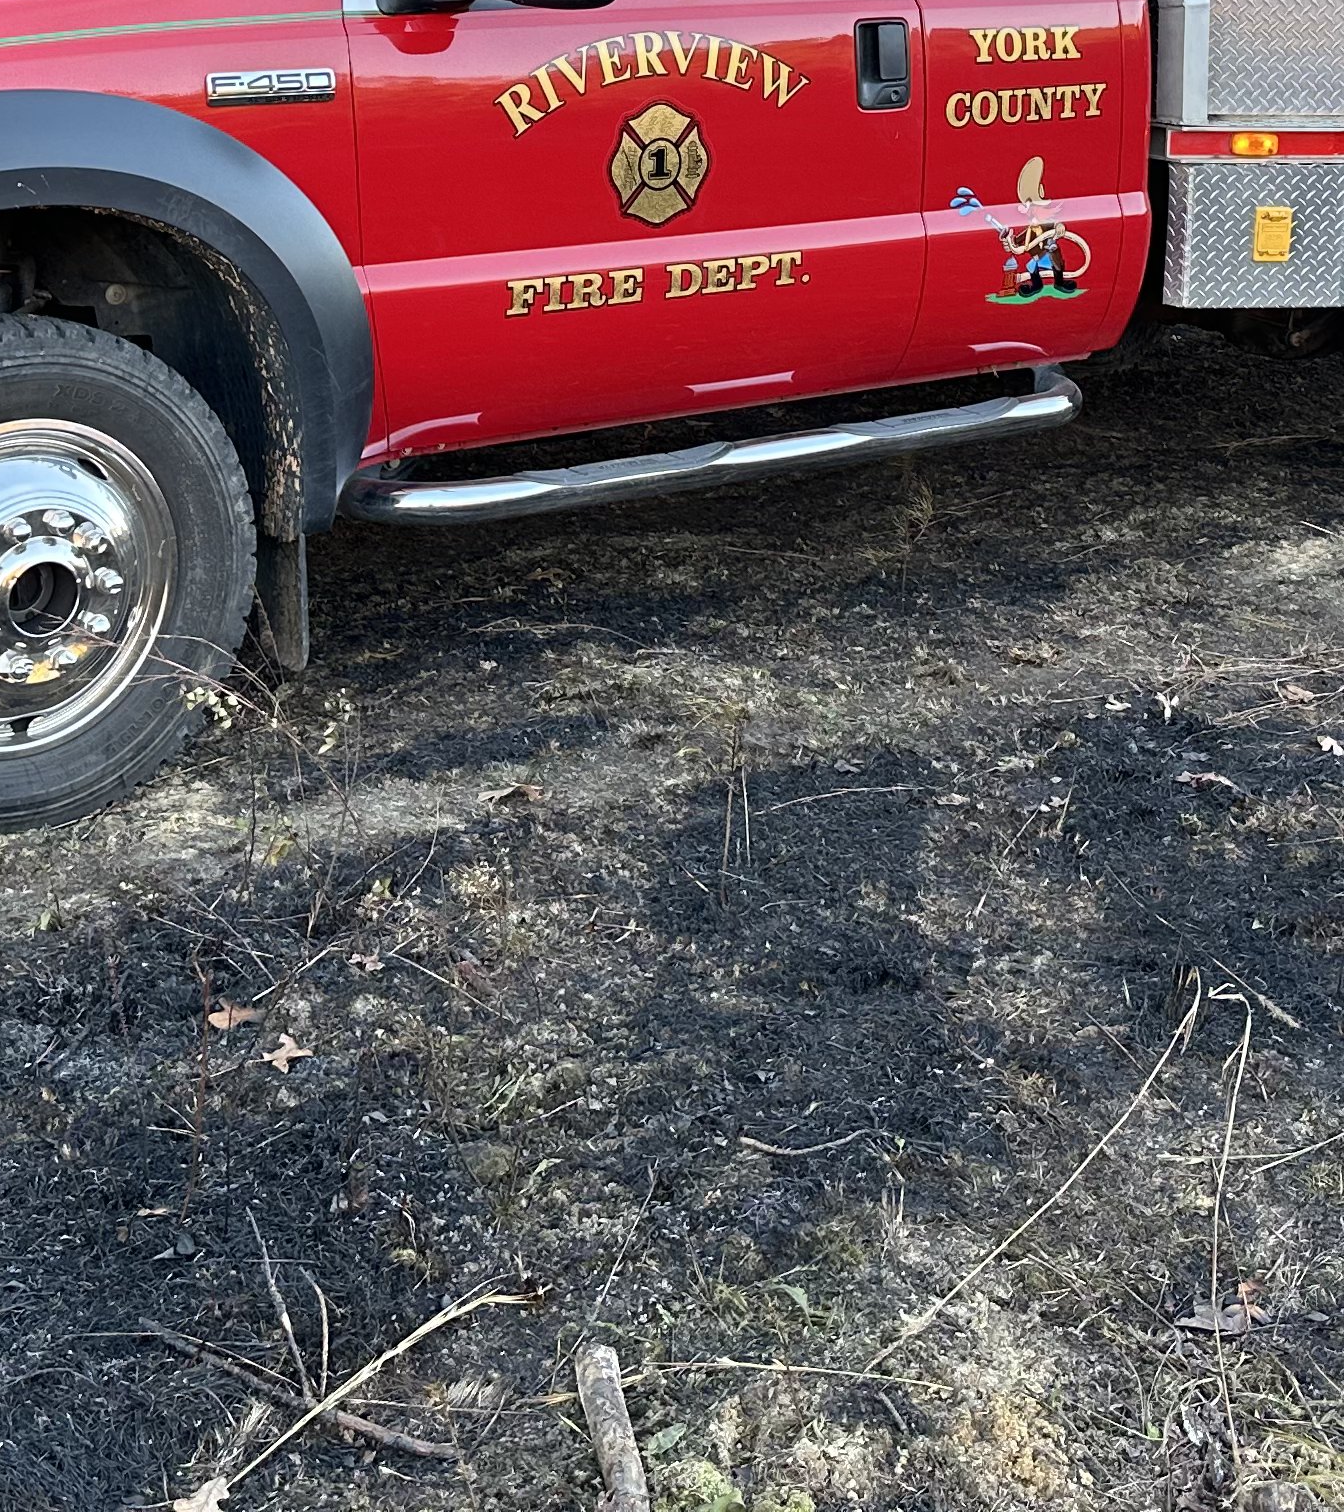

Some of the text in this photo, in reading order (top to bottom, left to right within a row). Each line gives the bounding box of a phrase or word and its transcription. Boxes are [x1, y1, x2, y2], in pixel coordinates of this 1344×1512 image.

[969, 25, 1082, 63] YORK
[210, 72, 333, 95] F-450
[494, 30, 810, 138] RIVERVIEW
[945, 82, 1107, 128] COUNTY
[646, 144, 671, 180] 1
[505, 251, 811, 316] FIRE DEPT.
